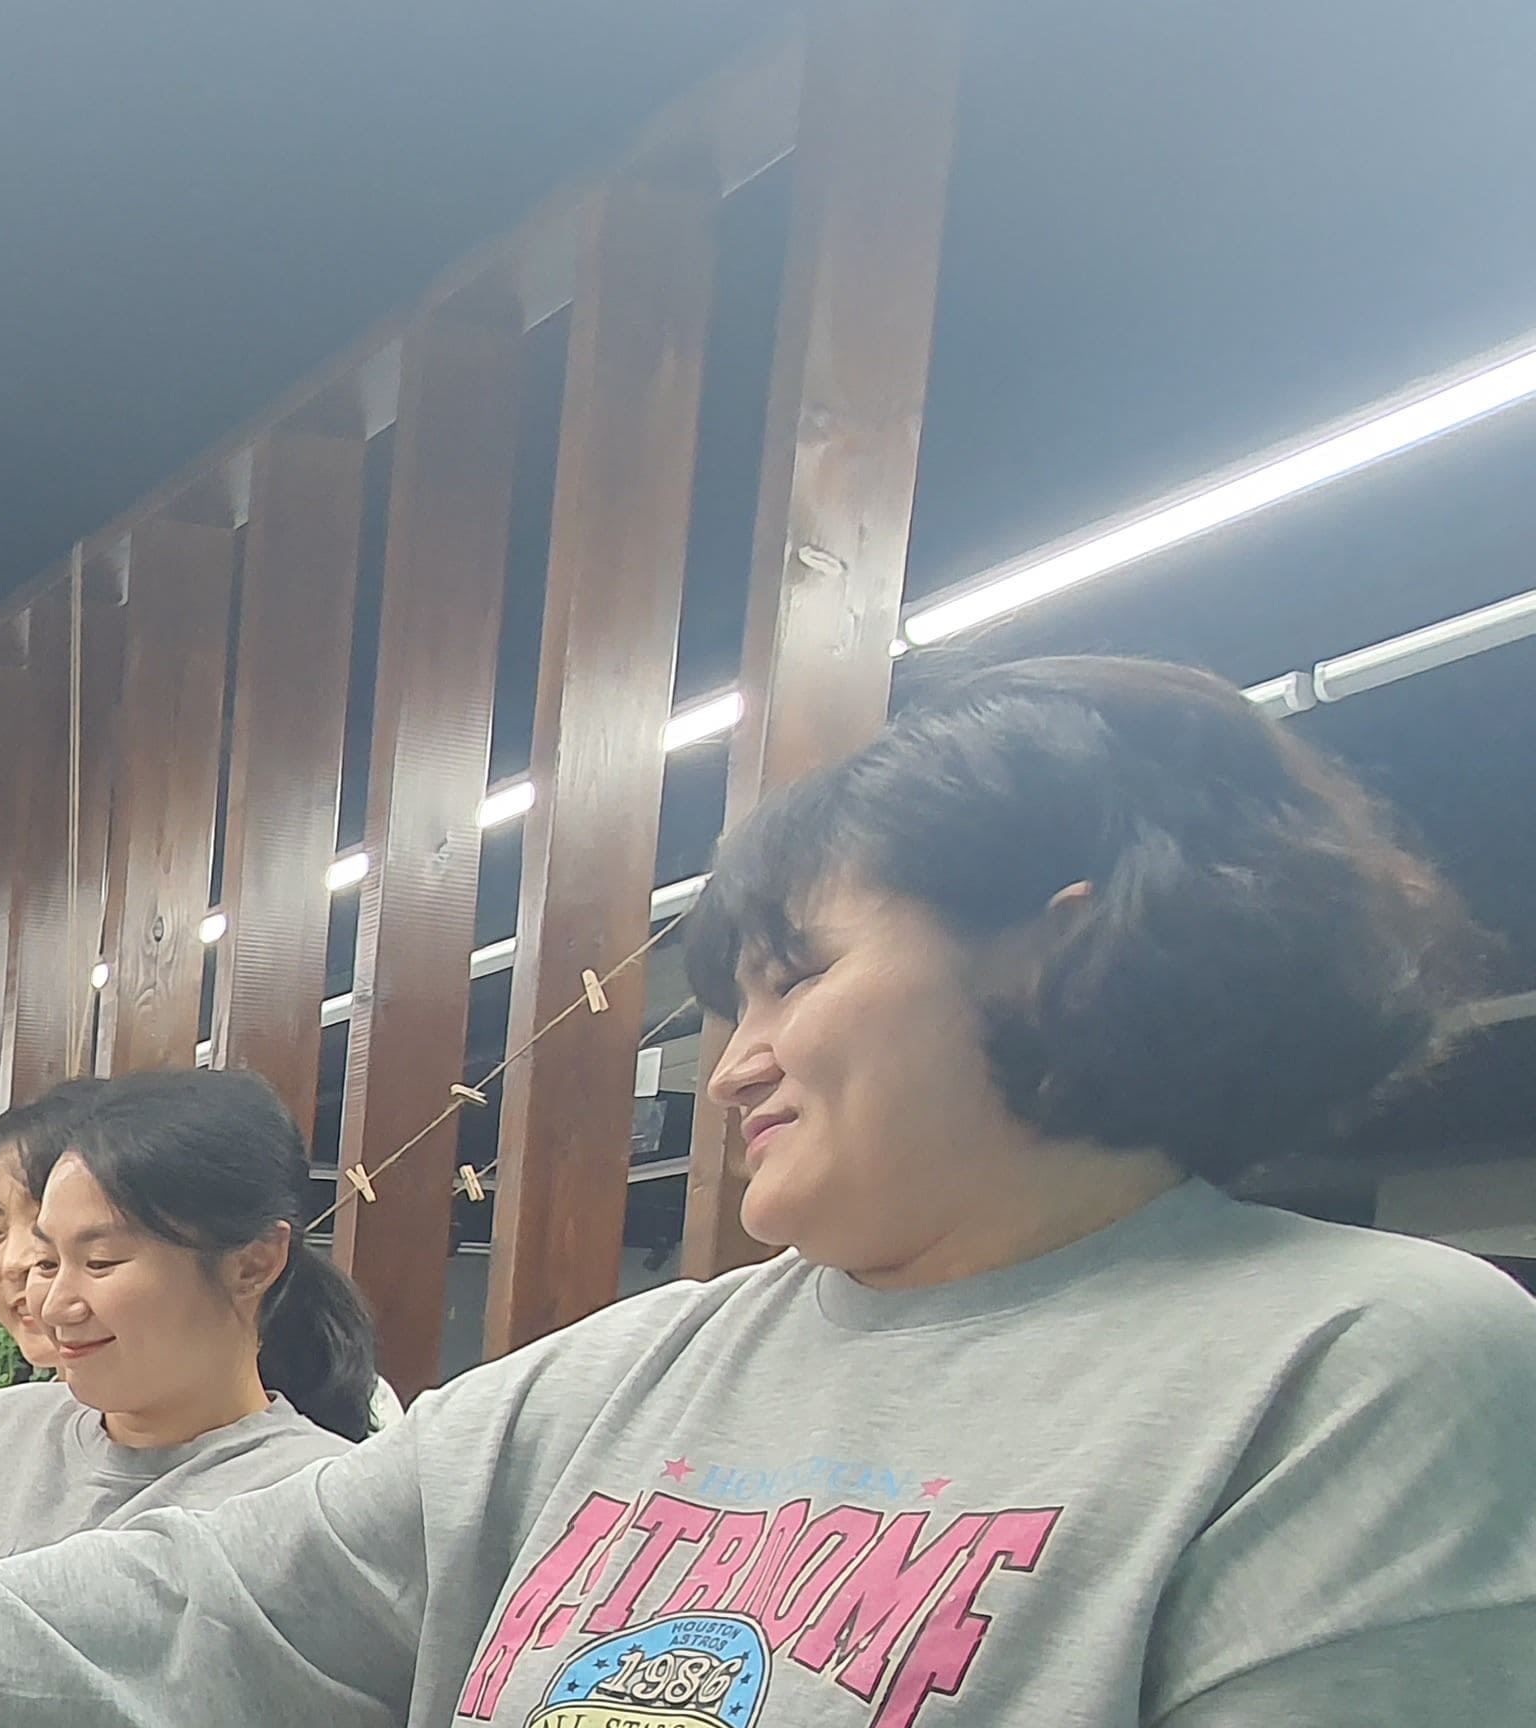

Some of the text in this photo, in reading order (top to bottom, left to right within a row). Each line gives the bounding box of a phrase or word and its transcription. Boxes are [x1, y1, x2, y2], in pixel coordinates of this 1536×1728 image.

[671, 1620, 743, 1640] HOUSTON
[668, 1632, 728, 1652] ASTROS
[595, 1651, 745, 1706] 1986
